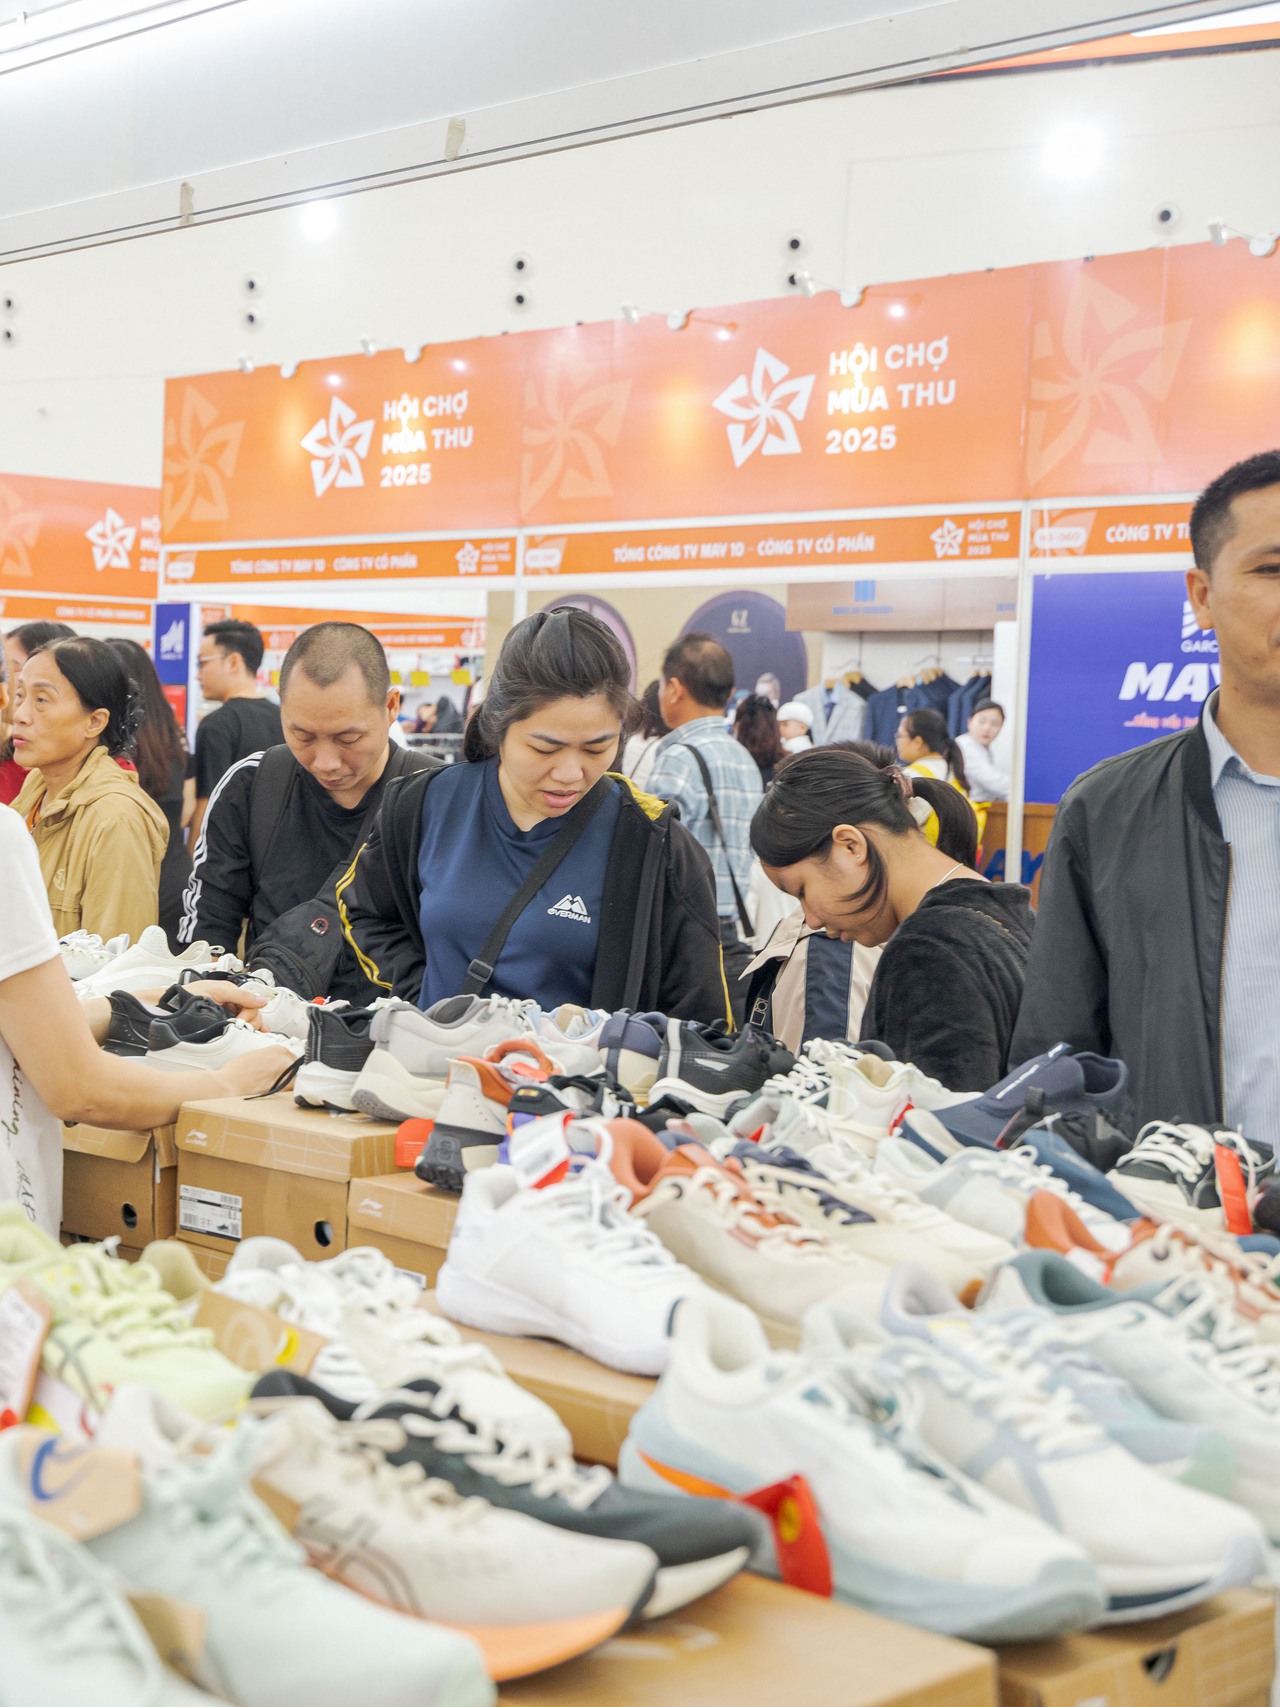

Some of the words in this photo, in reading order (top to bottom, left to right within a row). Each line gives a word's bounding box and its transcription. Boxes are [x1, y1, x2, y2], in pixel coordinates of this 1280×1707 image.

[884, 335, 948, 373] CHỢ
[422, 388, 469, 420] CHỢ
[896, 378, 956, 409] THU
[431, 426, 473, 450] THU
[825, 424, 897, 455] 2025
[379, 463, 432, 488] 2025
[140, 515, 162, 533] HỘ
[1105, 522, 1150, 543] CÔNG
[756, 536, 793, 557] CÔNG
